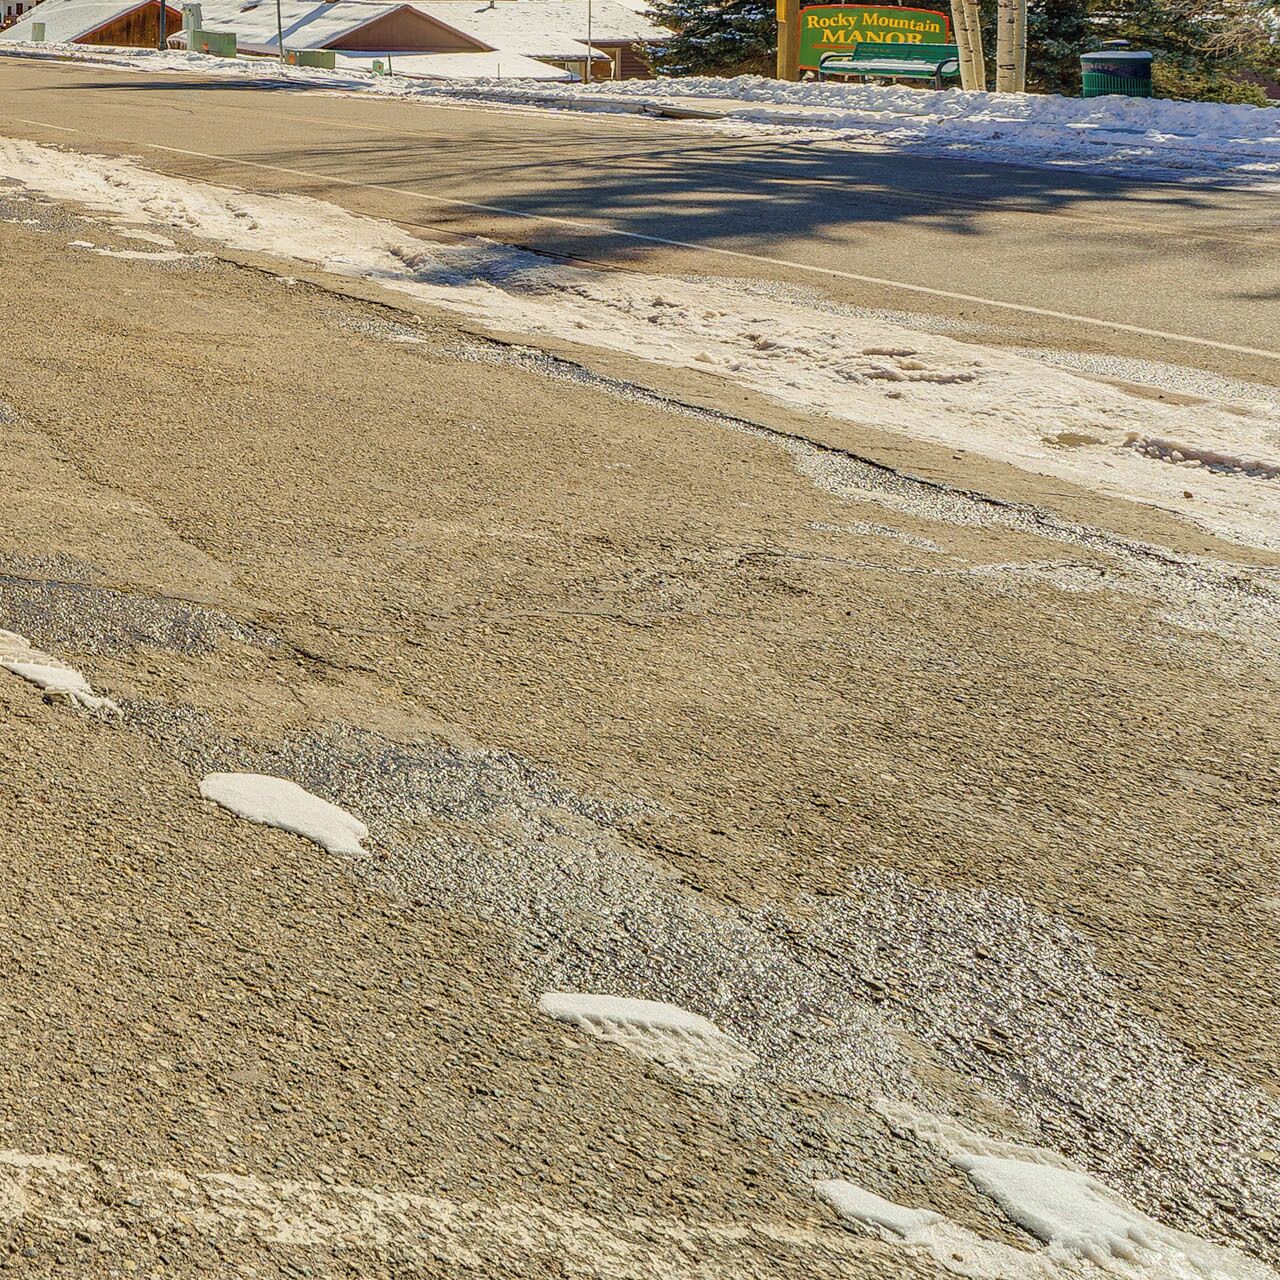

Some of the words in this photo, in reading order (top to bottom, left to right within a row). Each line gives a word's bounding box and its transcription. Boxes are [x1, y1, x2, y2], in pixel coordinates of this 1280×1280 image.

[806, 13, 857, 30] Rocky
[862, 12, 941, 33] Mountain
[821, 29, 923, 44] MANOR
